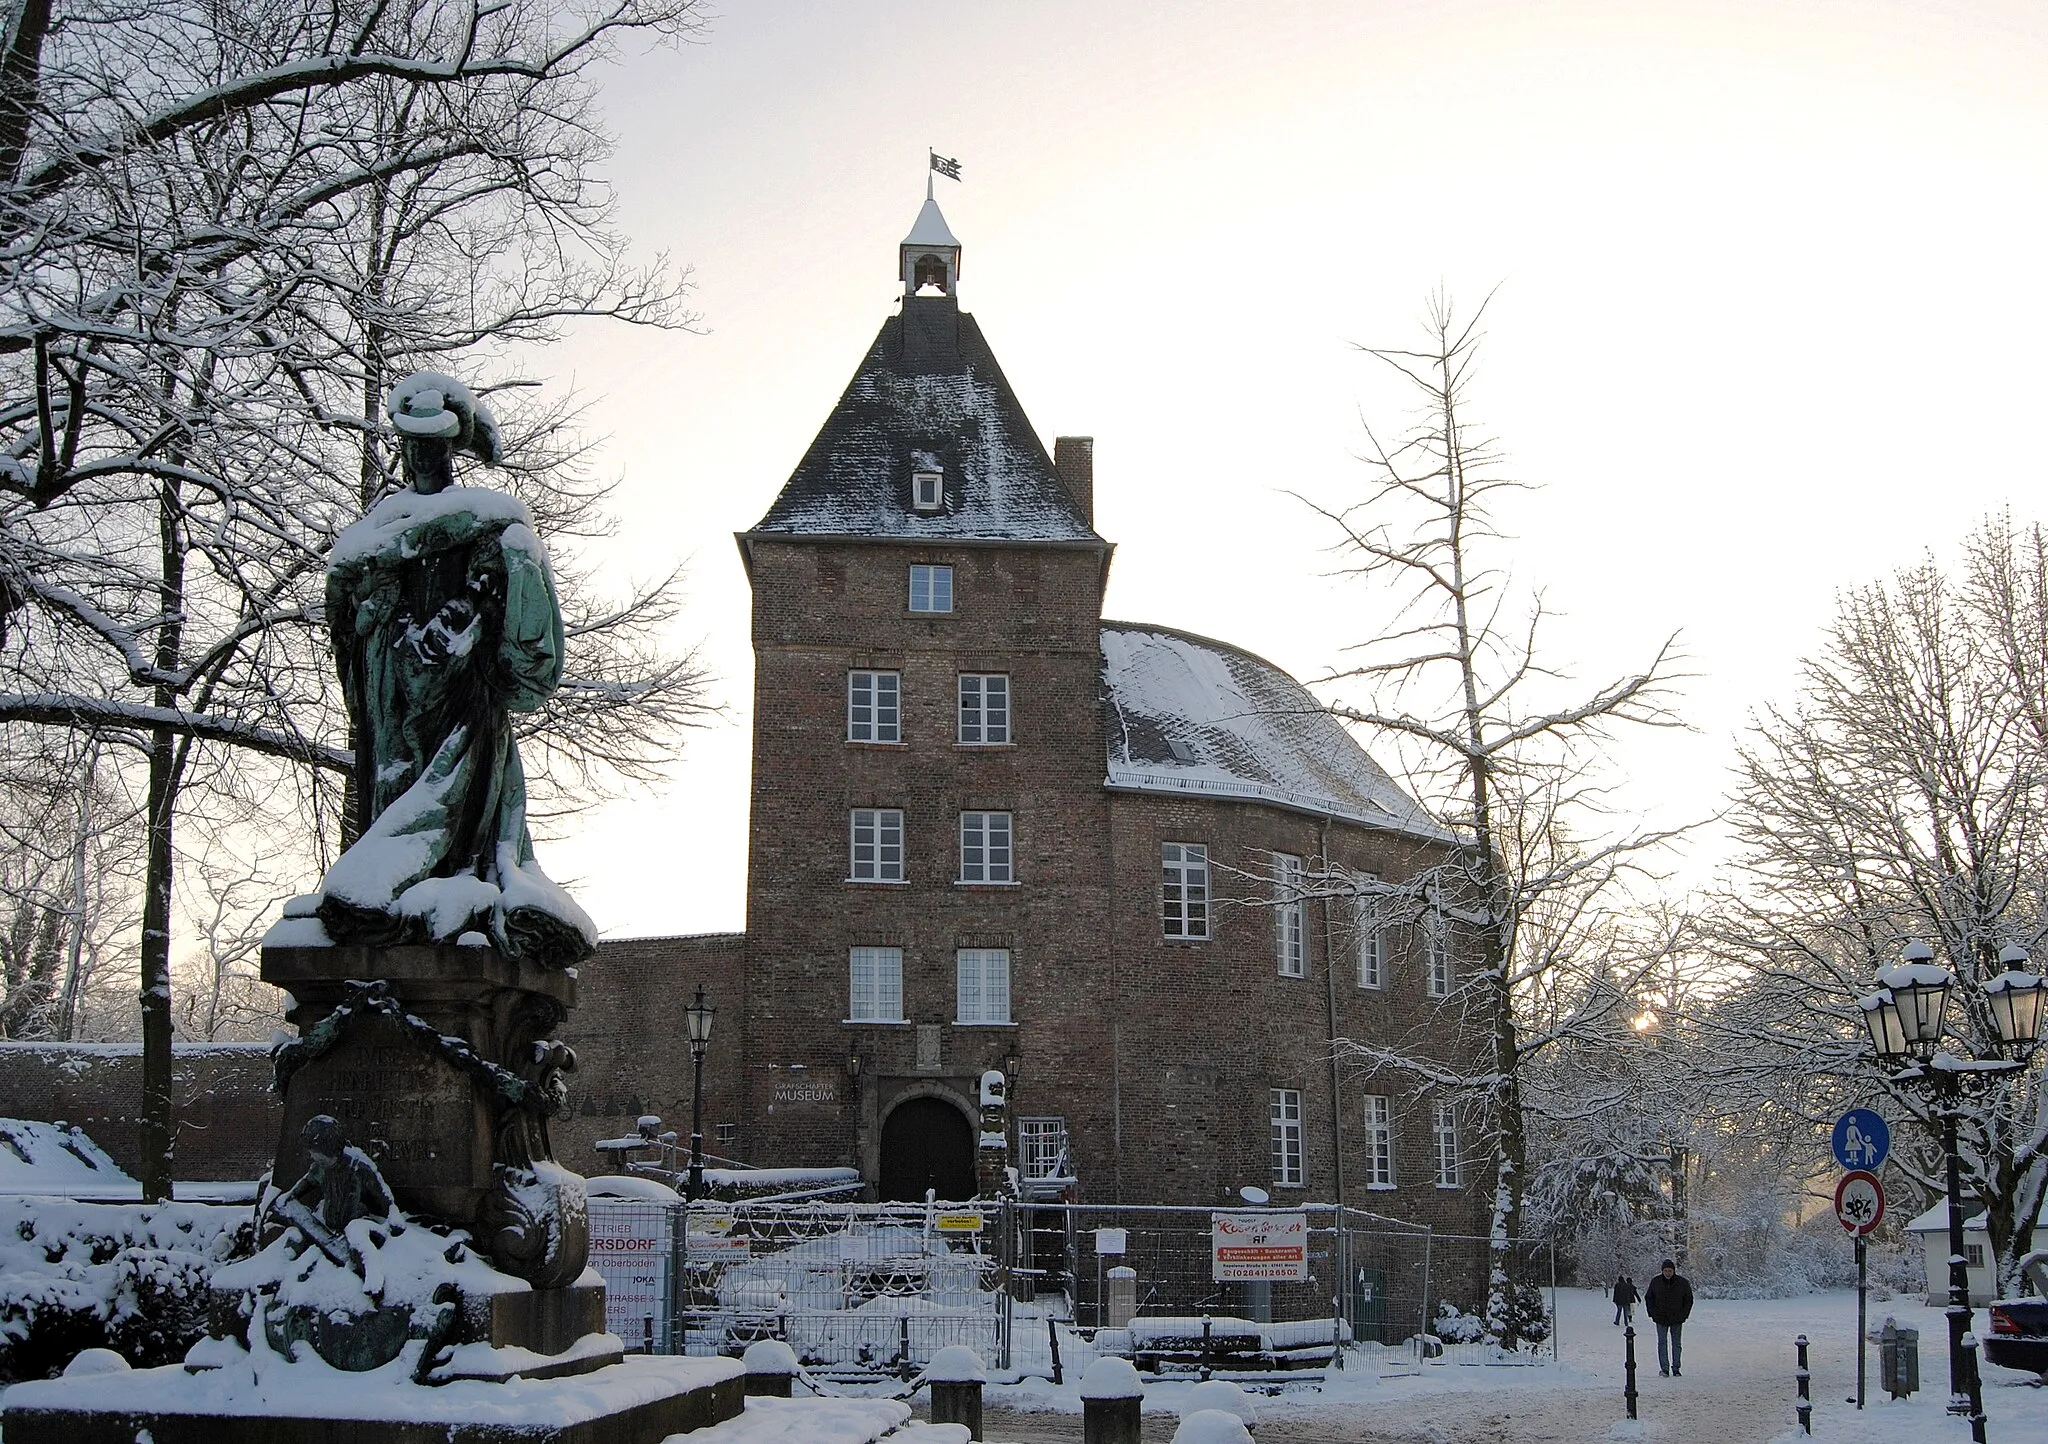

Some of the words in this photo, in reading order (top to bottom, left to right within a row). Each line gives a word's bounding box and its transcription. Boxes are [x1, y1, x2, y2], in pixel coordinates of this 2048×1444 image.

[774, 1090, 834, 1101] MUSEUM
[602, 1258, 655, 1268] Oberboden
[632, 1275, 655, 1284] JOKA
[605, 1306, 627, 1314] ERS
